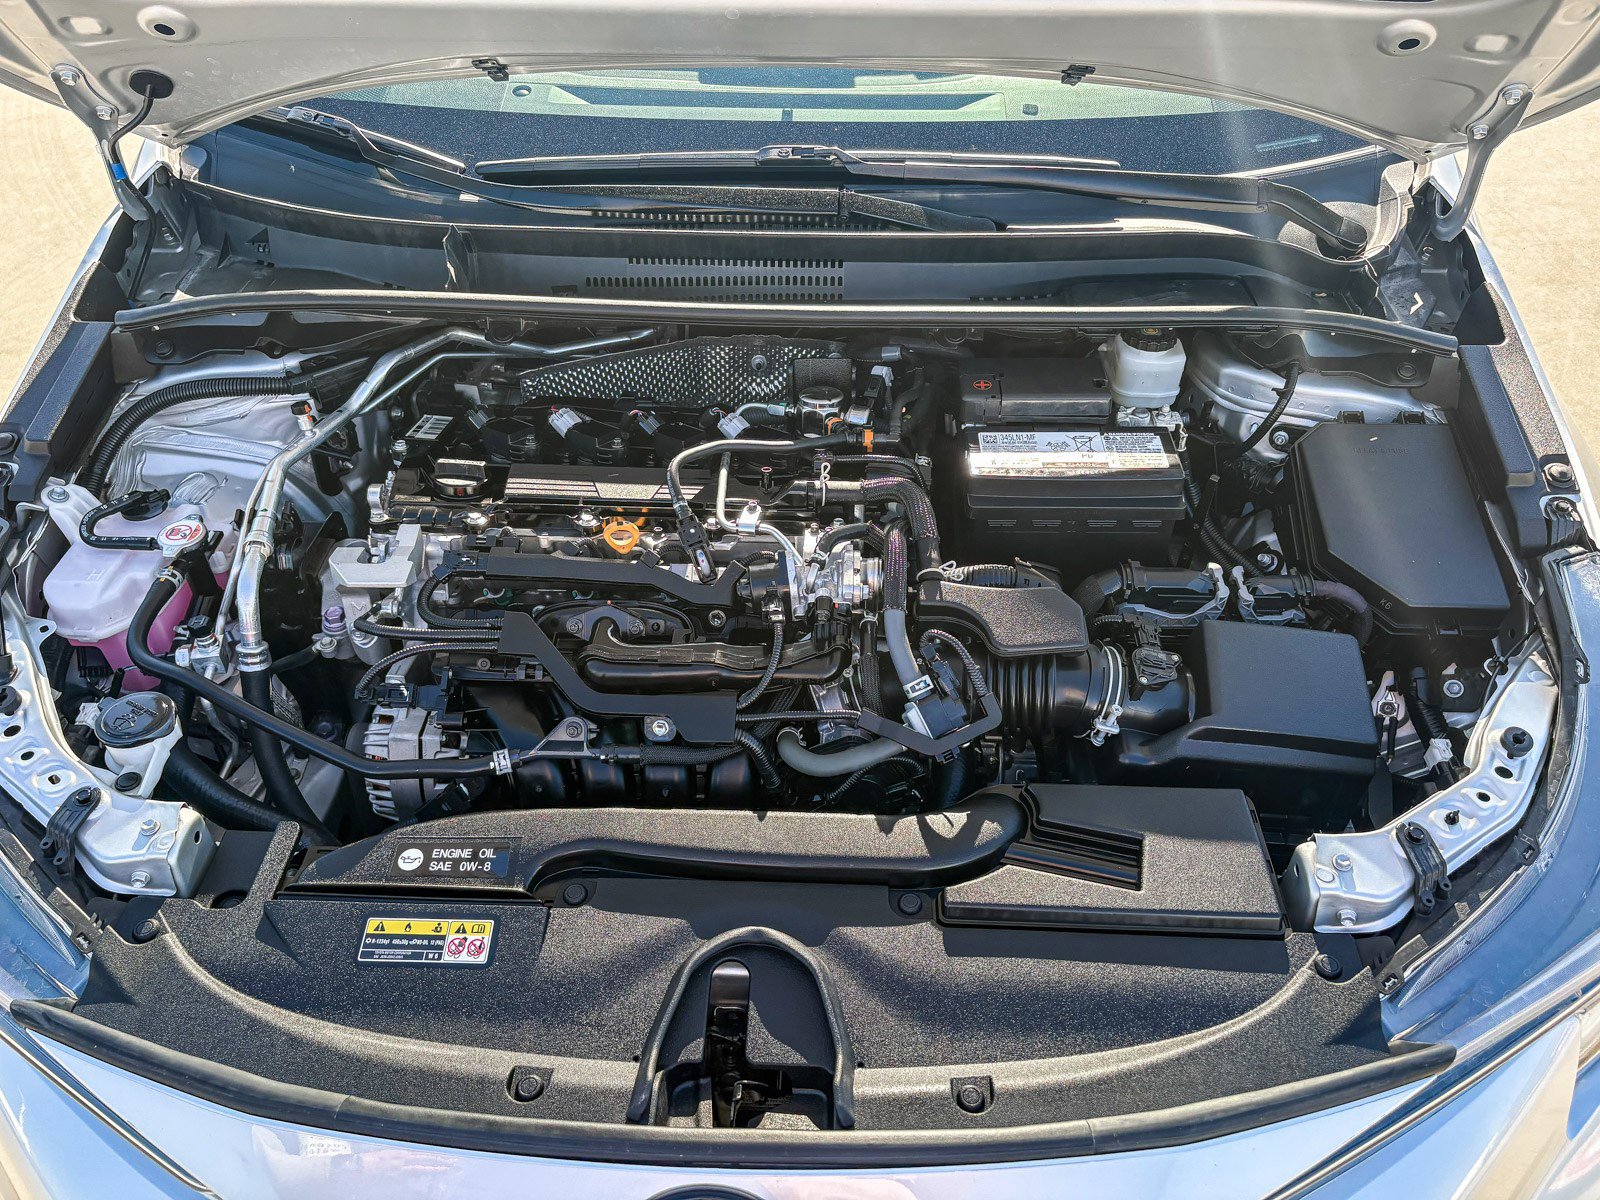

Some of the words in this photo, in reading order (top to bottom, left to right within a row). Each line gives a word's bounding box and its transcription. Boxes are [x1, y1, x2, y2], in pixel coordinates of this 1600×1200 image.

[431, 848, 473, 858] ENGINE
[478, 848, 497, 858] OIL
[428, 861, 453, 871] SAE
[459, 861, 491, 872] 0W-8
